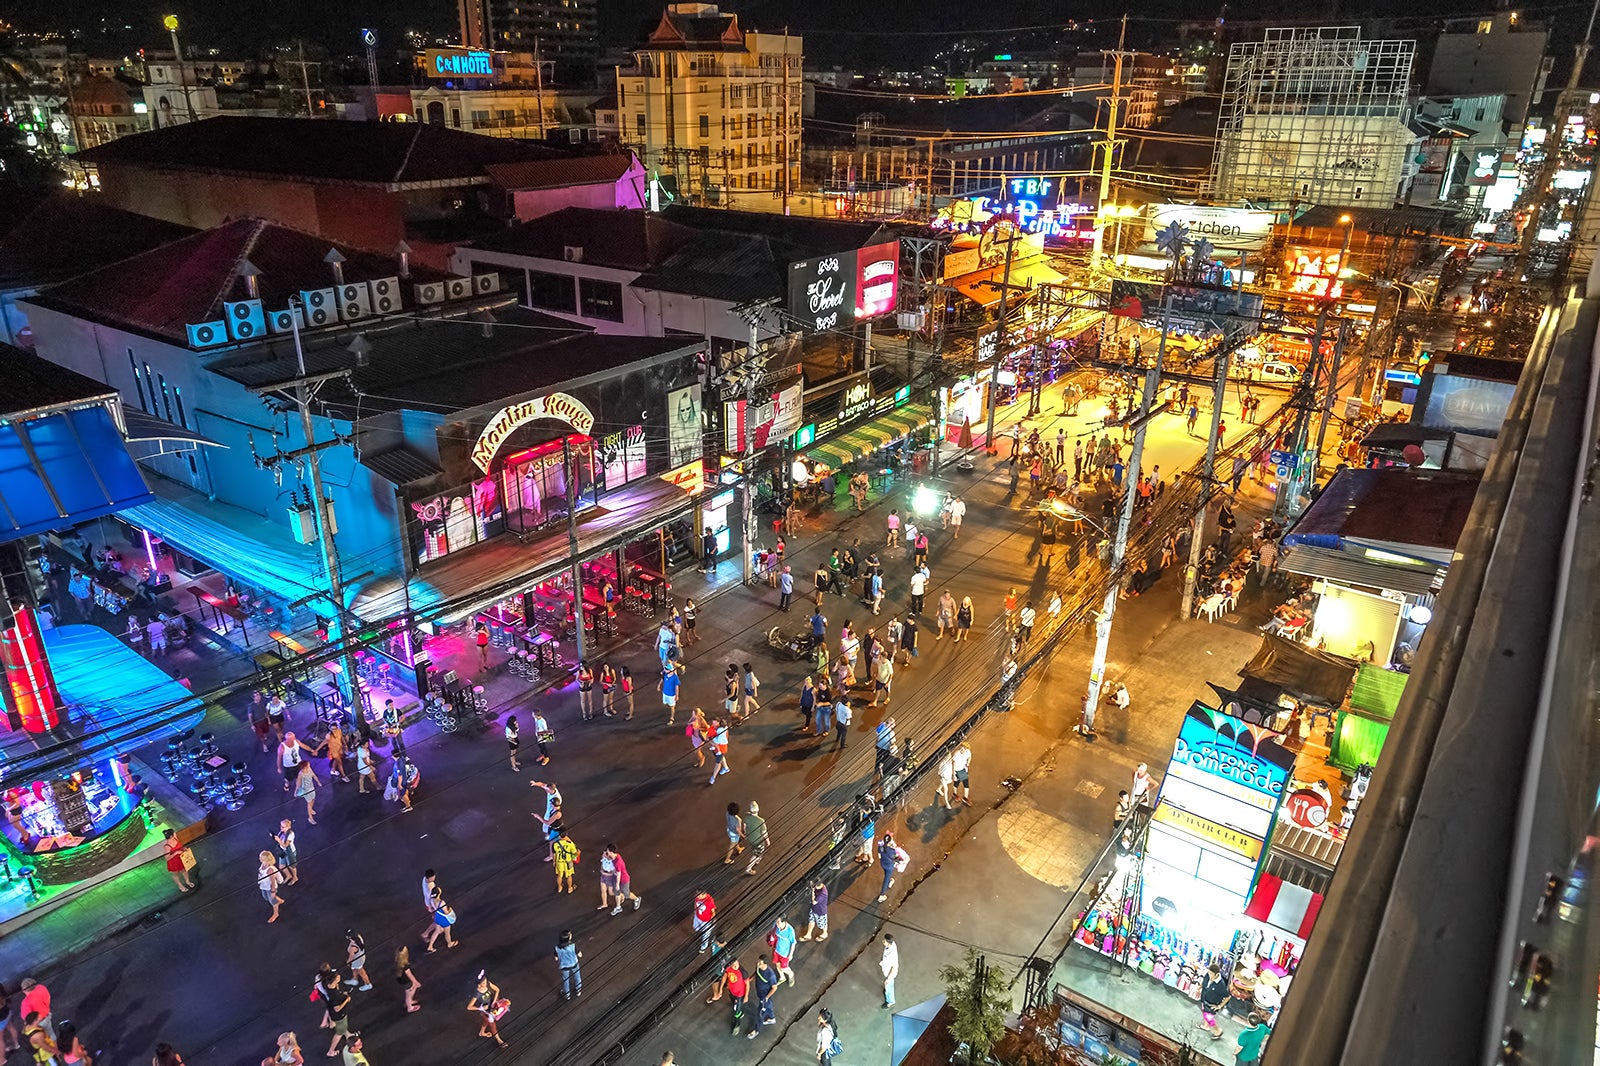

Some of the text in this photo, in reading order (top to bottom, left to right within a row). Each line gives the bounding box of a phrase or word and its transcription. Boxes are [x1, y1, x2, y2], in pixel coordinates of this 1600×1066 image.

[461, 56, 493, 75] HOTEL
[1029, 216, 1061, 235] club
[474, 401, 536, 468] Moulin
[542, 392, 593, 431] Rouge
[603, 431, 622, 447] NIGHT
[626, 424, 643, 438] CLUB
[1173, 737, 1284, 795] Promenade
[1202, 746, 1259, 774] PATONG
